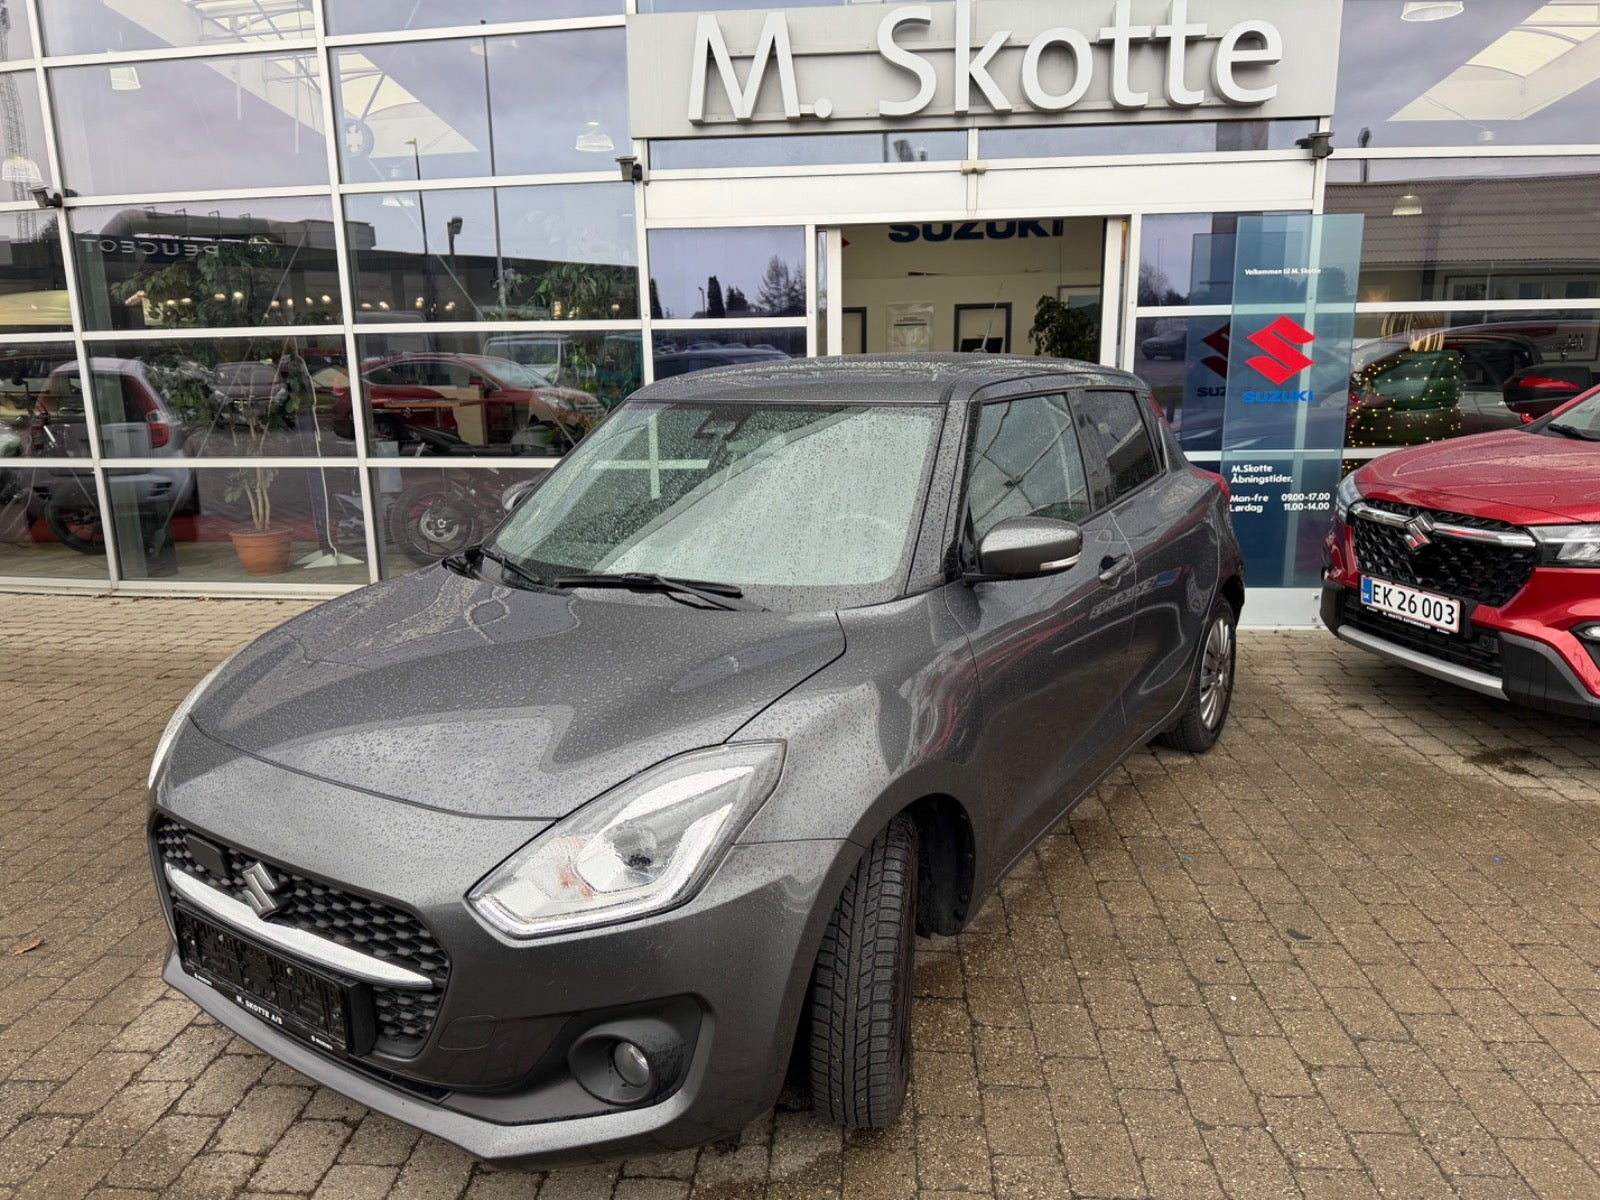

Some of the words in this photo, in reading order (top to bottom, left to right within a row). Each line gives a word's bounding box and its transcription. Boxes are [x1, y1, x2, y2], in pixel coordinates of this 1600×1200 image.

[687, 11, 833, 126] M.
[877, 0, 1283, 117] Skotte
[888, 219, 1064, 243] SUZUKI
[1283, 267, 1291, 275] til
[1300, 267, 1321, 275] Skotte
[1242, 391, 1314, 403] SUZUKI
[1231, 474, 1293, 485] Åbningstider.
[1230, 494, 1269, 503] Man-fre
[1281, 492, 1331, 502] 09.00-17.00
[1229, 503, 1264, 514] Lørdag
[1284, 502, 1330, 511] 11.00-14.00
[1373, 584, 1393, 607] EK
[1397, 591, 1417, 613] 26
[1422, 597, 1455, 625] 003
